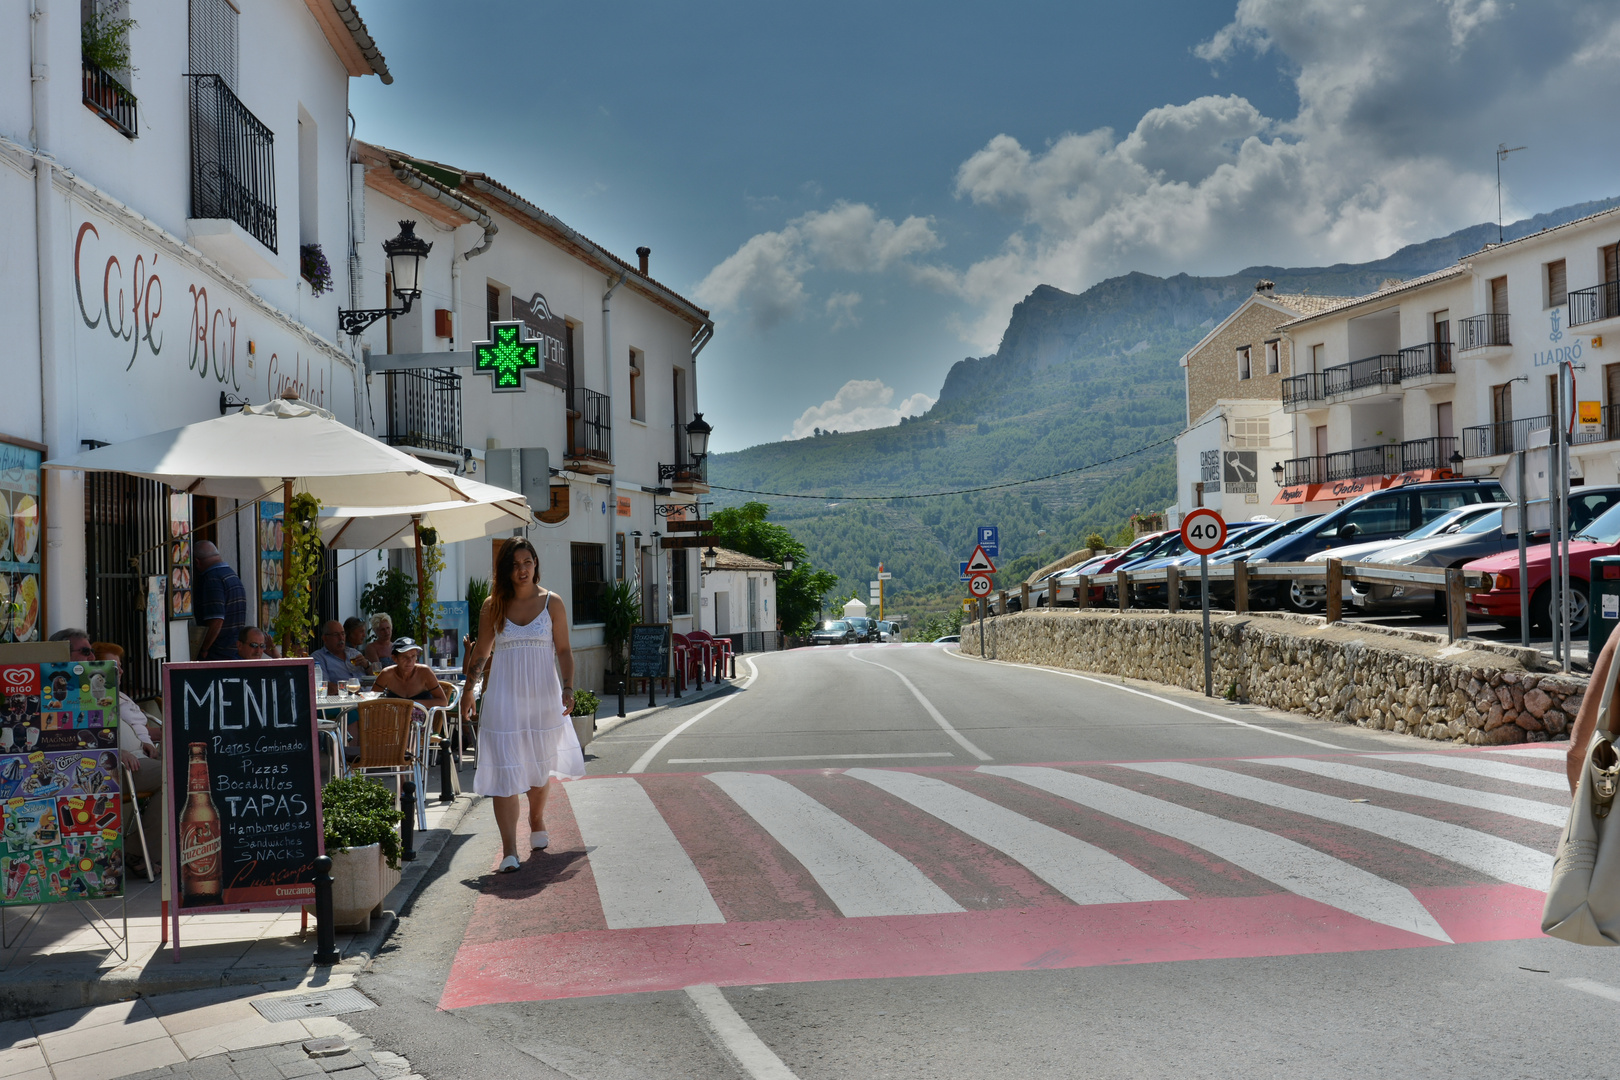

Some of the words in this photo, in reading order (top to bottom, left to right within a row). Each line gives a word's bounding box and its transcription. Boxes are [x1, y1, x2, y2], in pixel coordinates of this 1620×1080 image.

[74, 222, 163, 372] Café
[188, 284, 241, 392] Bar
[1534, 339, 1582, 367] LLADRÓ
[1402, 475, 1420, 485] Bar
[1280, 488, 1303, 501] Regalos
[1332, 482, 1365, 496] Gadea
[983, 529, 992, 540] P
[1190, 524, 1218, 539] 40
[973, 581, 988, 590] 20
[183, 678, 298, 731] MENU
[41, 735, 76, 744] MAGNUM
[29, 753, 43, 761] NUEVO
[54, 752, 83, 771] Cornetto
[240, 759, 289, 774] Pizzas
[216, 775, 294, 791] Bocadillos
[8, 798, 24, 806] NUEVO
[69, 798, 84, 807] NUEVO
[225, 794, 308, 818] TAPAS
[101, 830, 117, 838] NUEVO
[229, 820, 312, 836] Hamburguesas
[234, 836, 303, 850] Sandwiches
[234, 849, 305, 863] SNACKS
[275, 886, 316, 897] Cruzcampo
